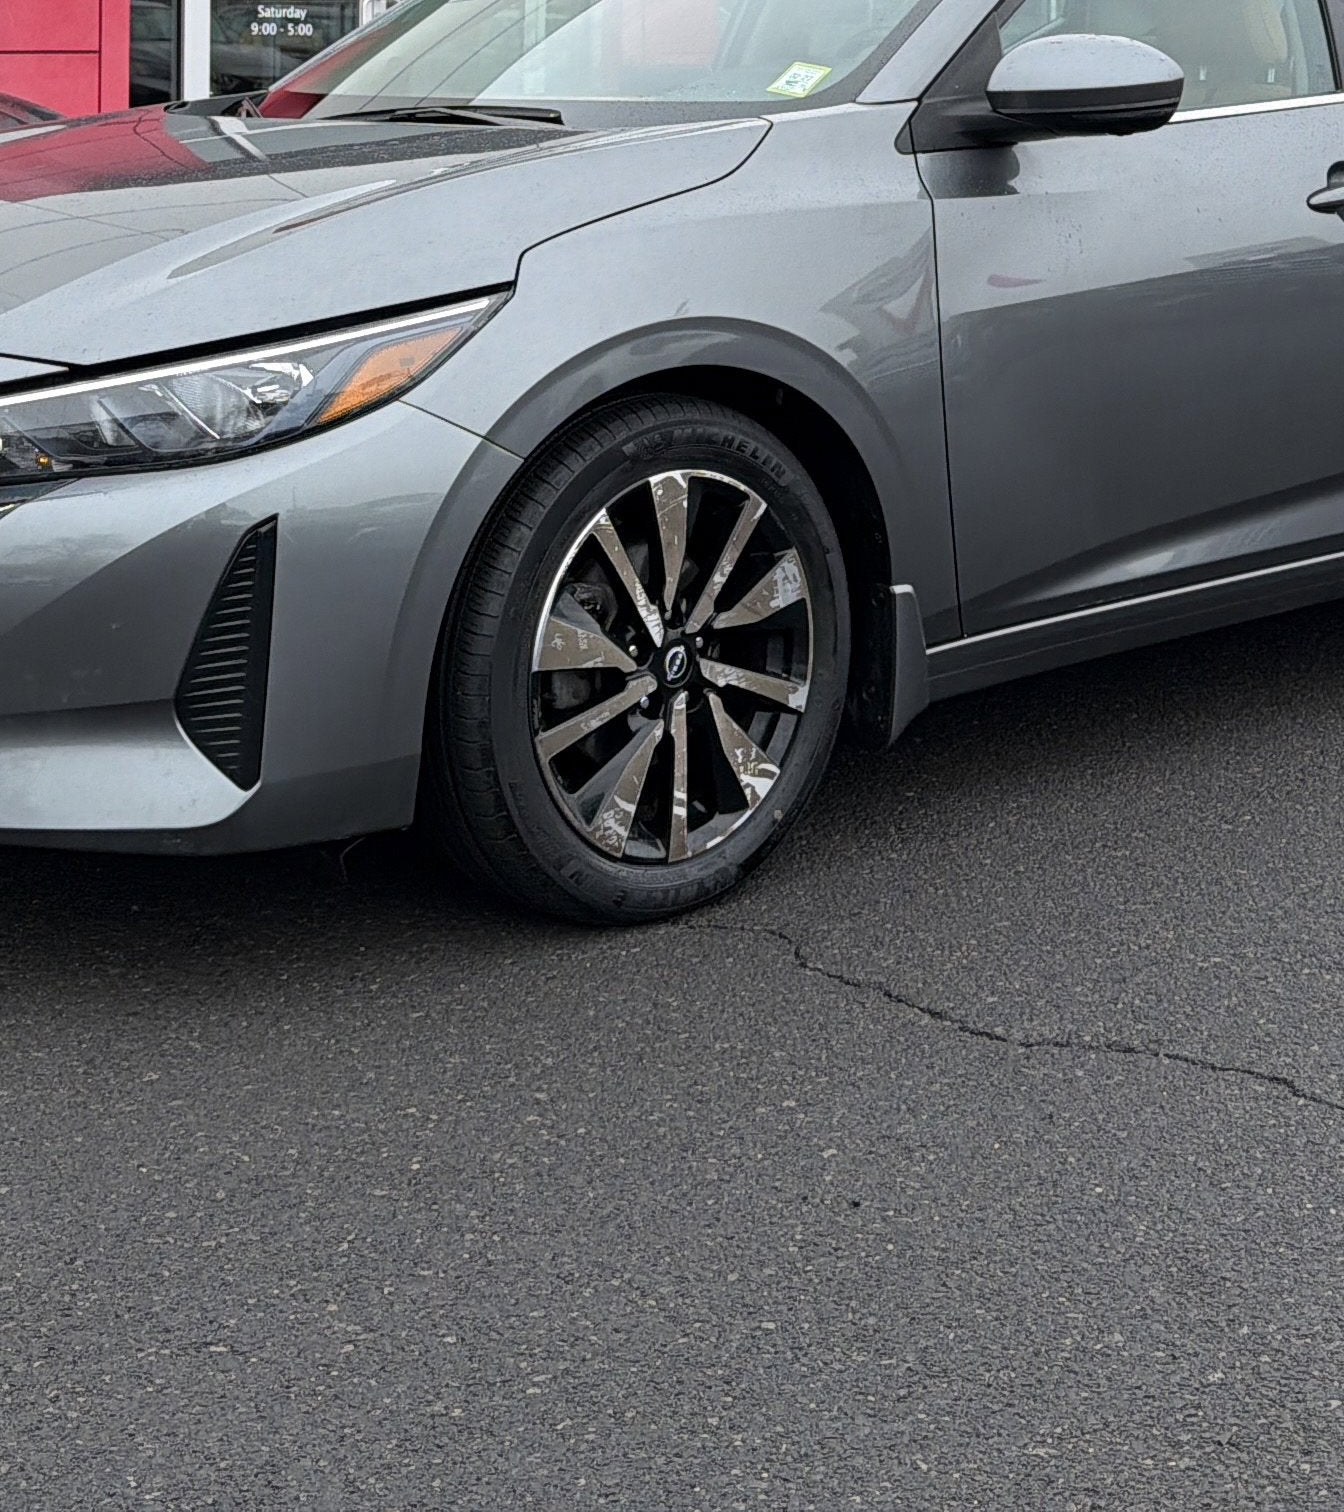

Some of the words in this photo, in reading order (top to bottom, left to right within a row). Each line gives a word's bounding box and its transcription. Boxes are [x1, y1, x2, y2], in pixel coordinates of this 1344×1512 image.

[257, 5, 307, 21] Saturday
[250, 22, 278, 36] 9:00
[287, 23, 313, 37] 5:00
